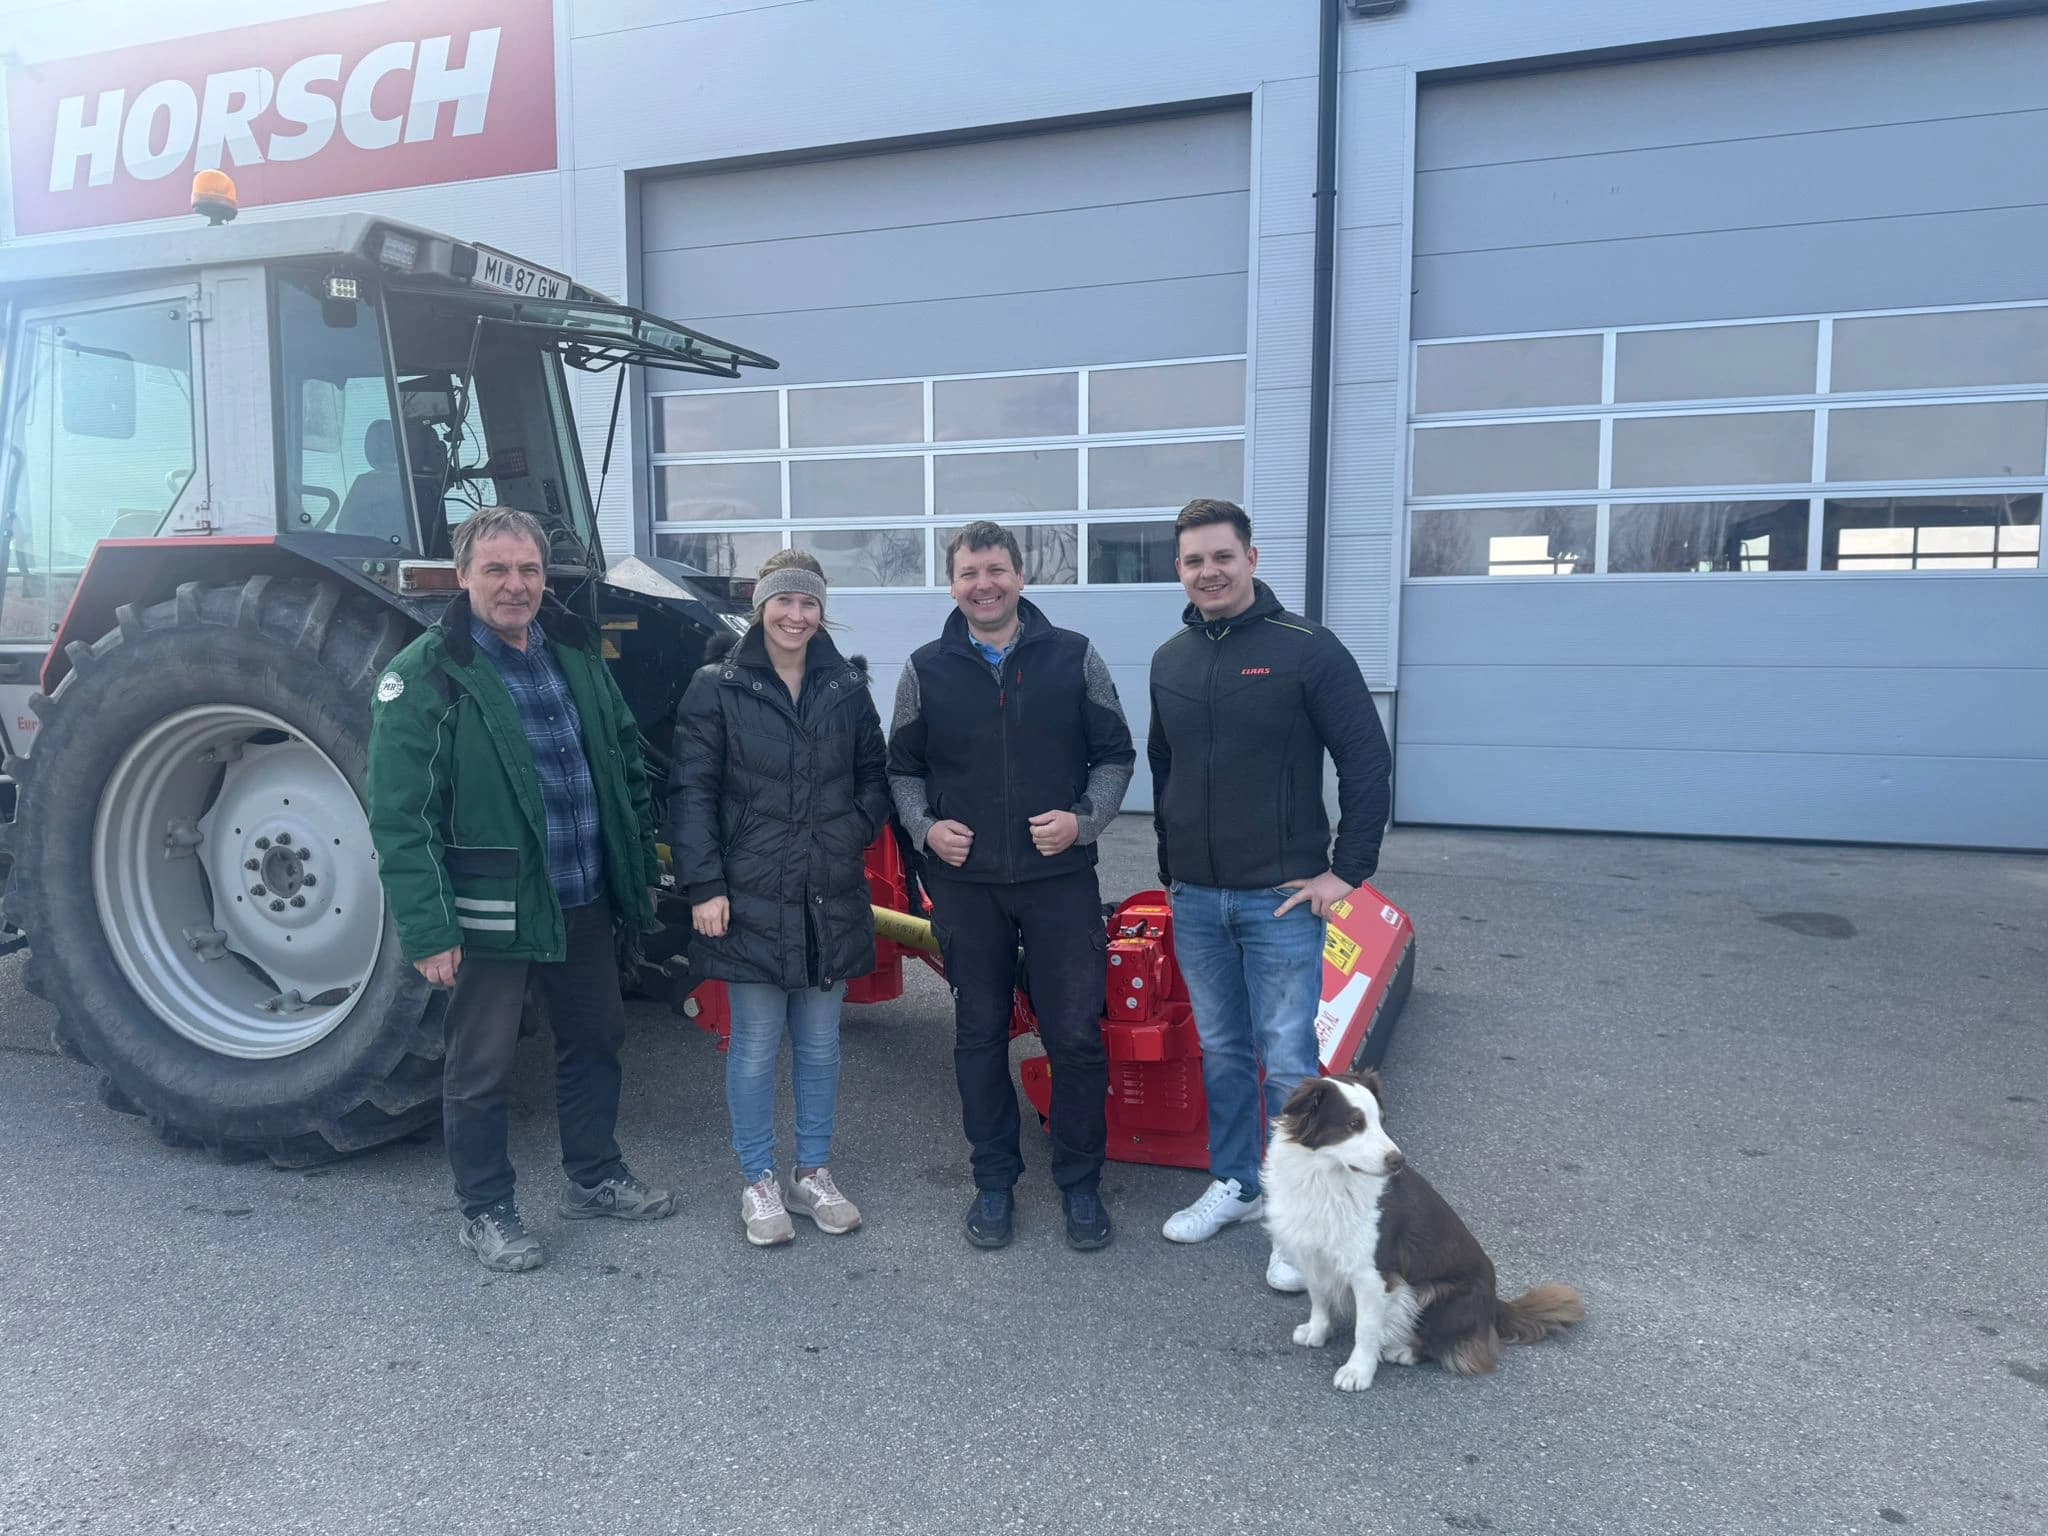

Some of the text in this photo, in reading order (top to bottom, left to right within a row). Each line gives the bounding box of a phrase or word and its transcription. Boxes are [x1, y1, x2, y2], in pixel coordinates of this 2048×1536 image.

[49, 27, 501, 192] HORSCH
[485, 256, 560, 298] MI 87 GW
[1240, 667, 1271, 675] CLAAS
[17, 716, 39, 731] Eur
